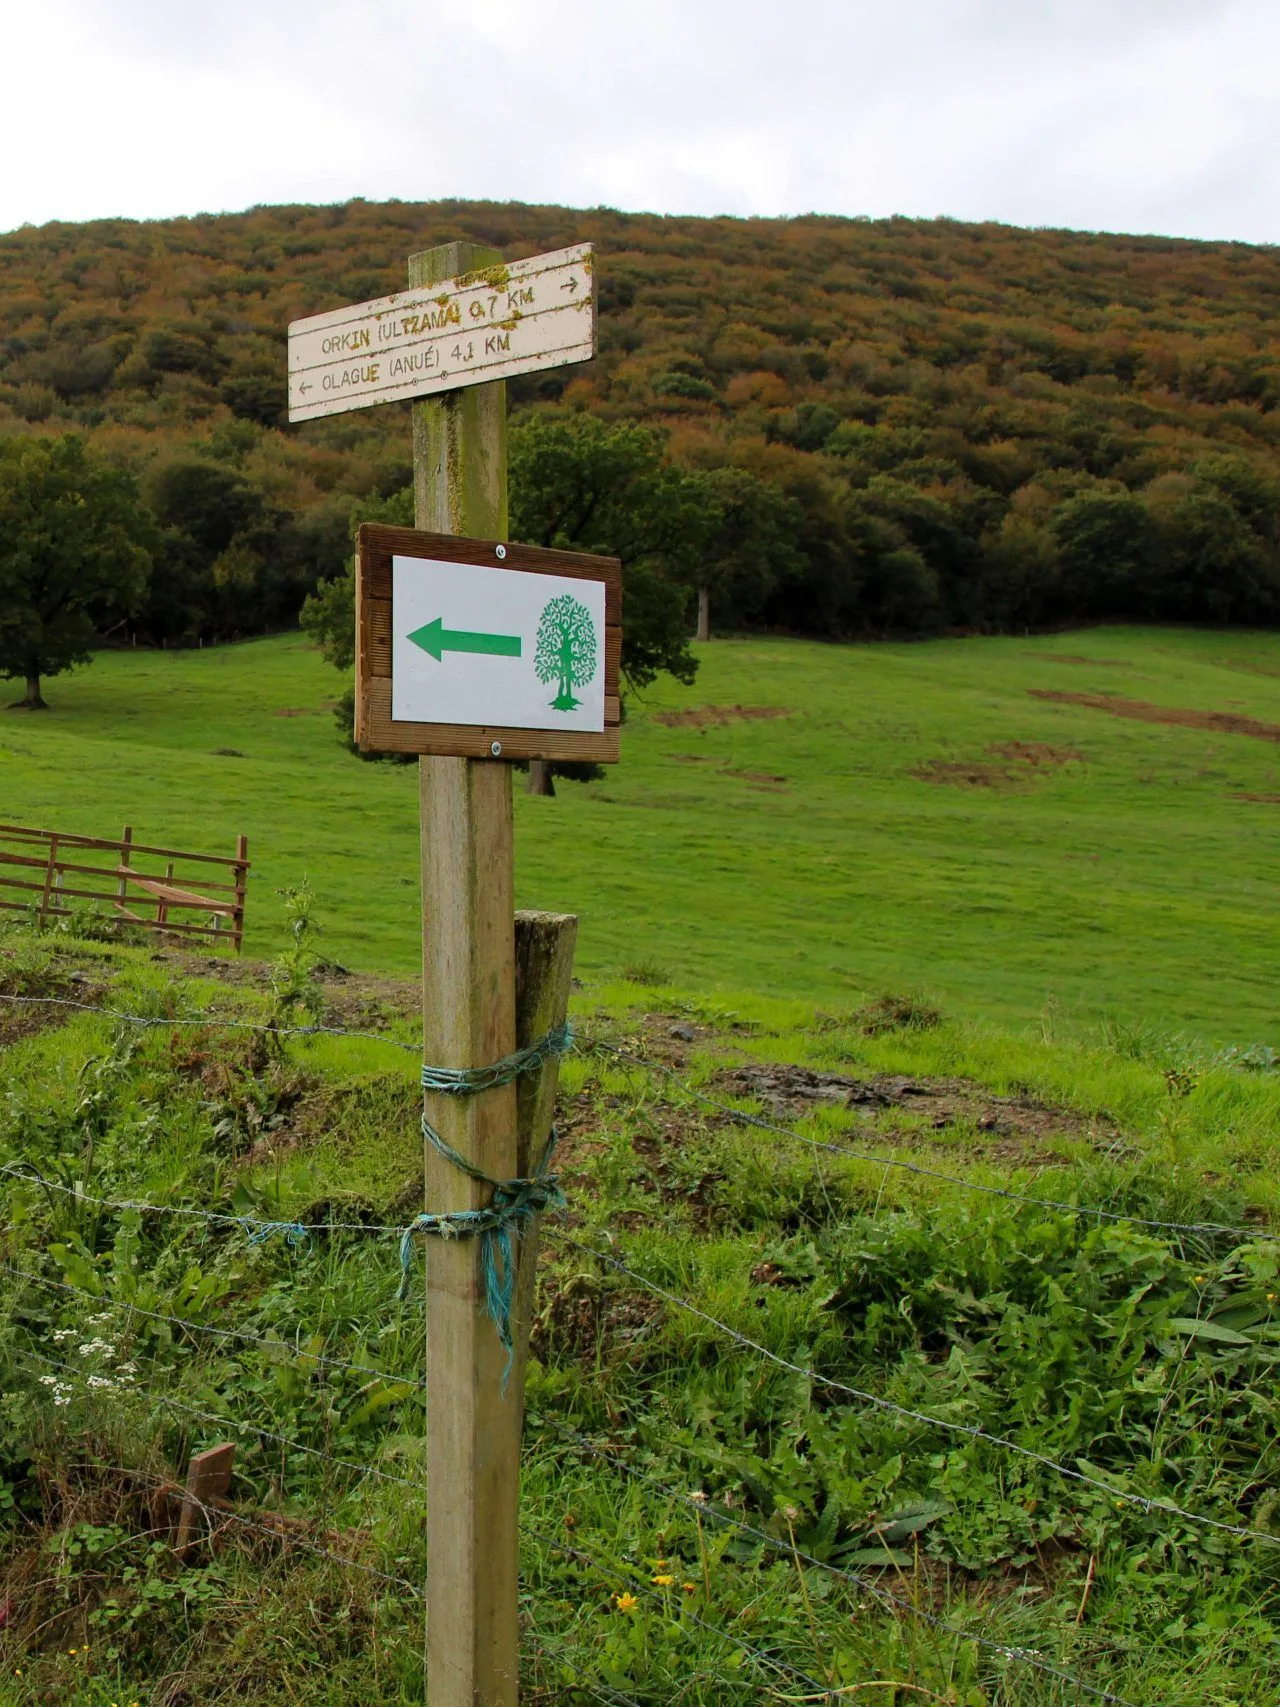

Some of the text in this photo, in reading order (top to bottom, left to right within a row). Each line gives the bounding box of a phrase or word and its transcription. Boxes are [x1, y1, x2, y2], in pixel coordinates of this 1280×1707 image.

[321, 327, 370, 354] ORKIN
[506, 286, 535, 310] KM
[322, 363, 380, 391] OLAGUE
[389, 345, 440, 377] (ANUÉ)
[484, 333, 510, 355] KM
